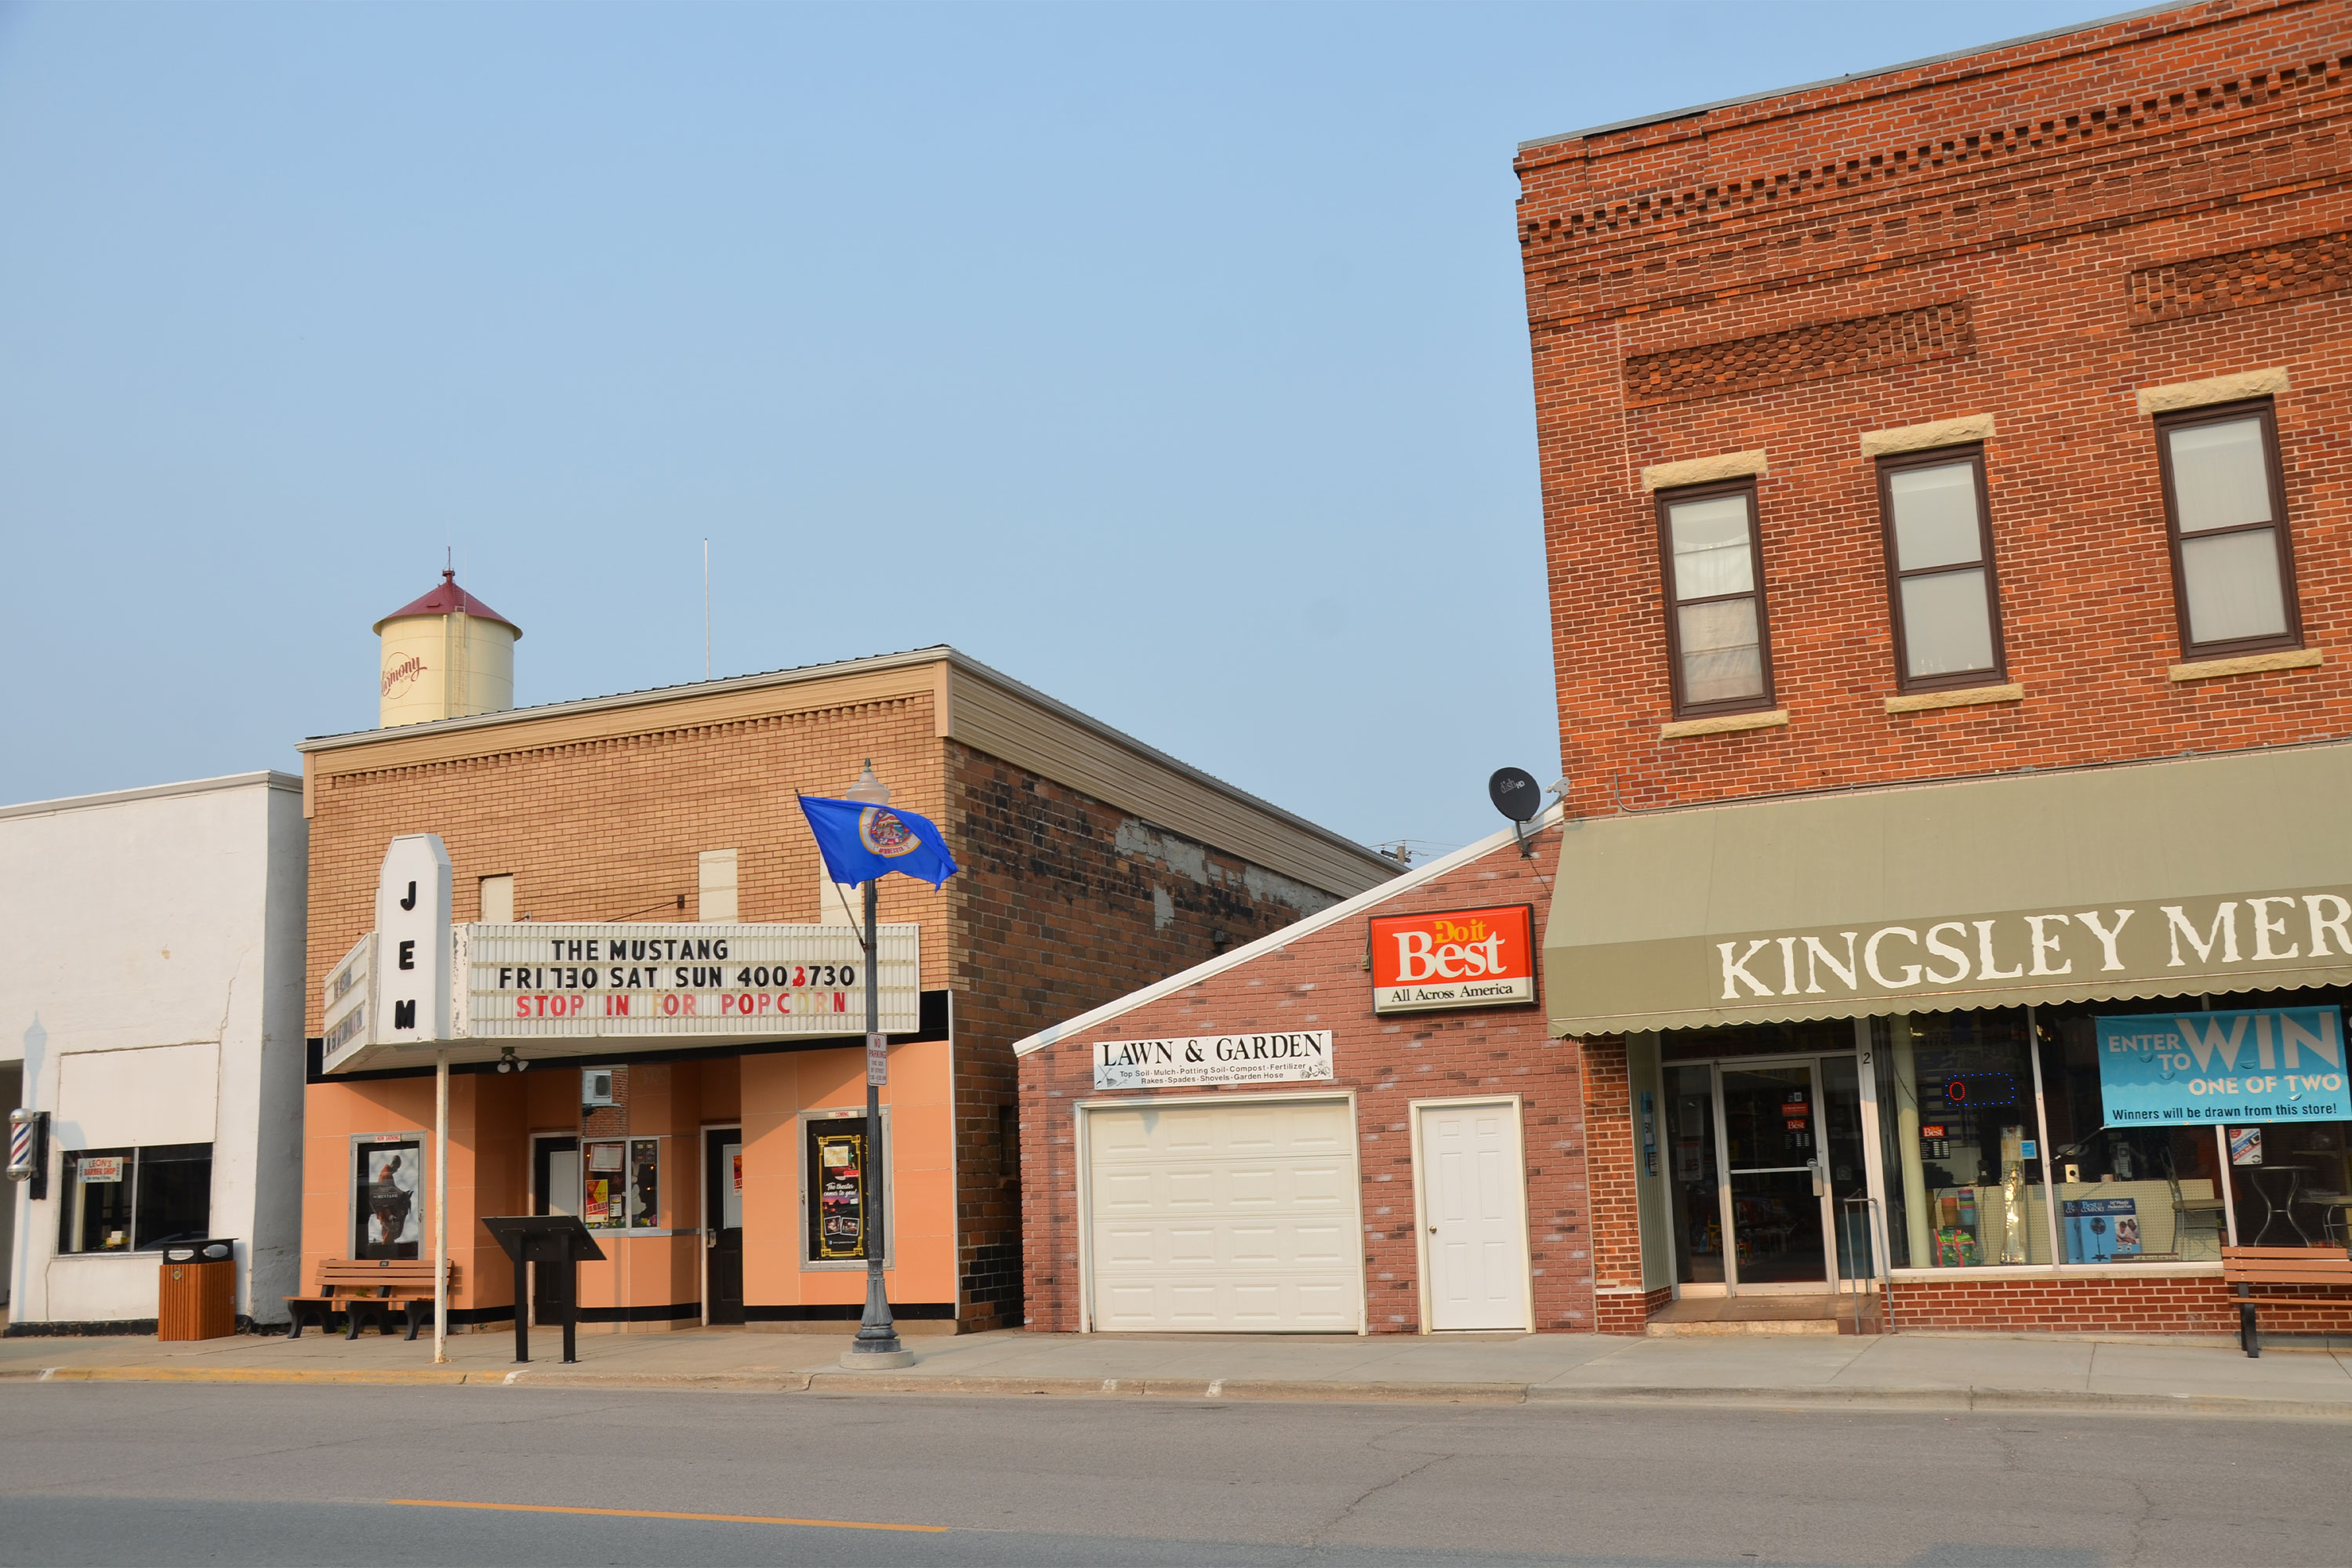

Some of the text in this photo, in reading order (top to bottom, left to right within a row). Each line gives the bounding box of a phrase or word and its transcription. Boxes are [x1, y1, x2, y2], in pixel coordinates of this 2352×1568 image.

[1433, 919, 1487, 944] Do it
[394, 880, 417, 1029] JEM
[552, 938, 728, 960] THE MUSTANG
[1392, 931, 1508, 982] Best
[1716, 894, 2352, 999] KINGSLEY MER
[499, 967, 542, 989] FRI
[611, 967, 658, 988] SAT
[676, 966, 722, 988] SUN
[737, 966, 788, 987] 400
[808, 965, 855, 986] 730
[1392, 983, 1513, 1003] All Across America
[517, 992, 845, 1018] STOP IN FOR POPCORN
[874, 1038, 881, 1048] NO
[1102, 1033, 1323, 1067] LAWN & GARDEN
[2108, 1033, 2183, 1053] ENTER
[2175, 1011, 2339, 1073] WIN
[869, 1049, 887, 1058] PARKING
[1864, 1052, 1871, 1065] 2
[2158, 1053, 2191, 1071] TO
[2188, 1073, 2341, 1095] ONE OF TWO
[2112, 1103, 2337, 1120] Winners will be drawn from this store!
[1924, 1127, 1944, 1137] Best
[89, 1159, 113, 1167] LEON'S
